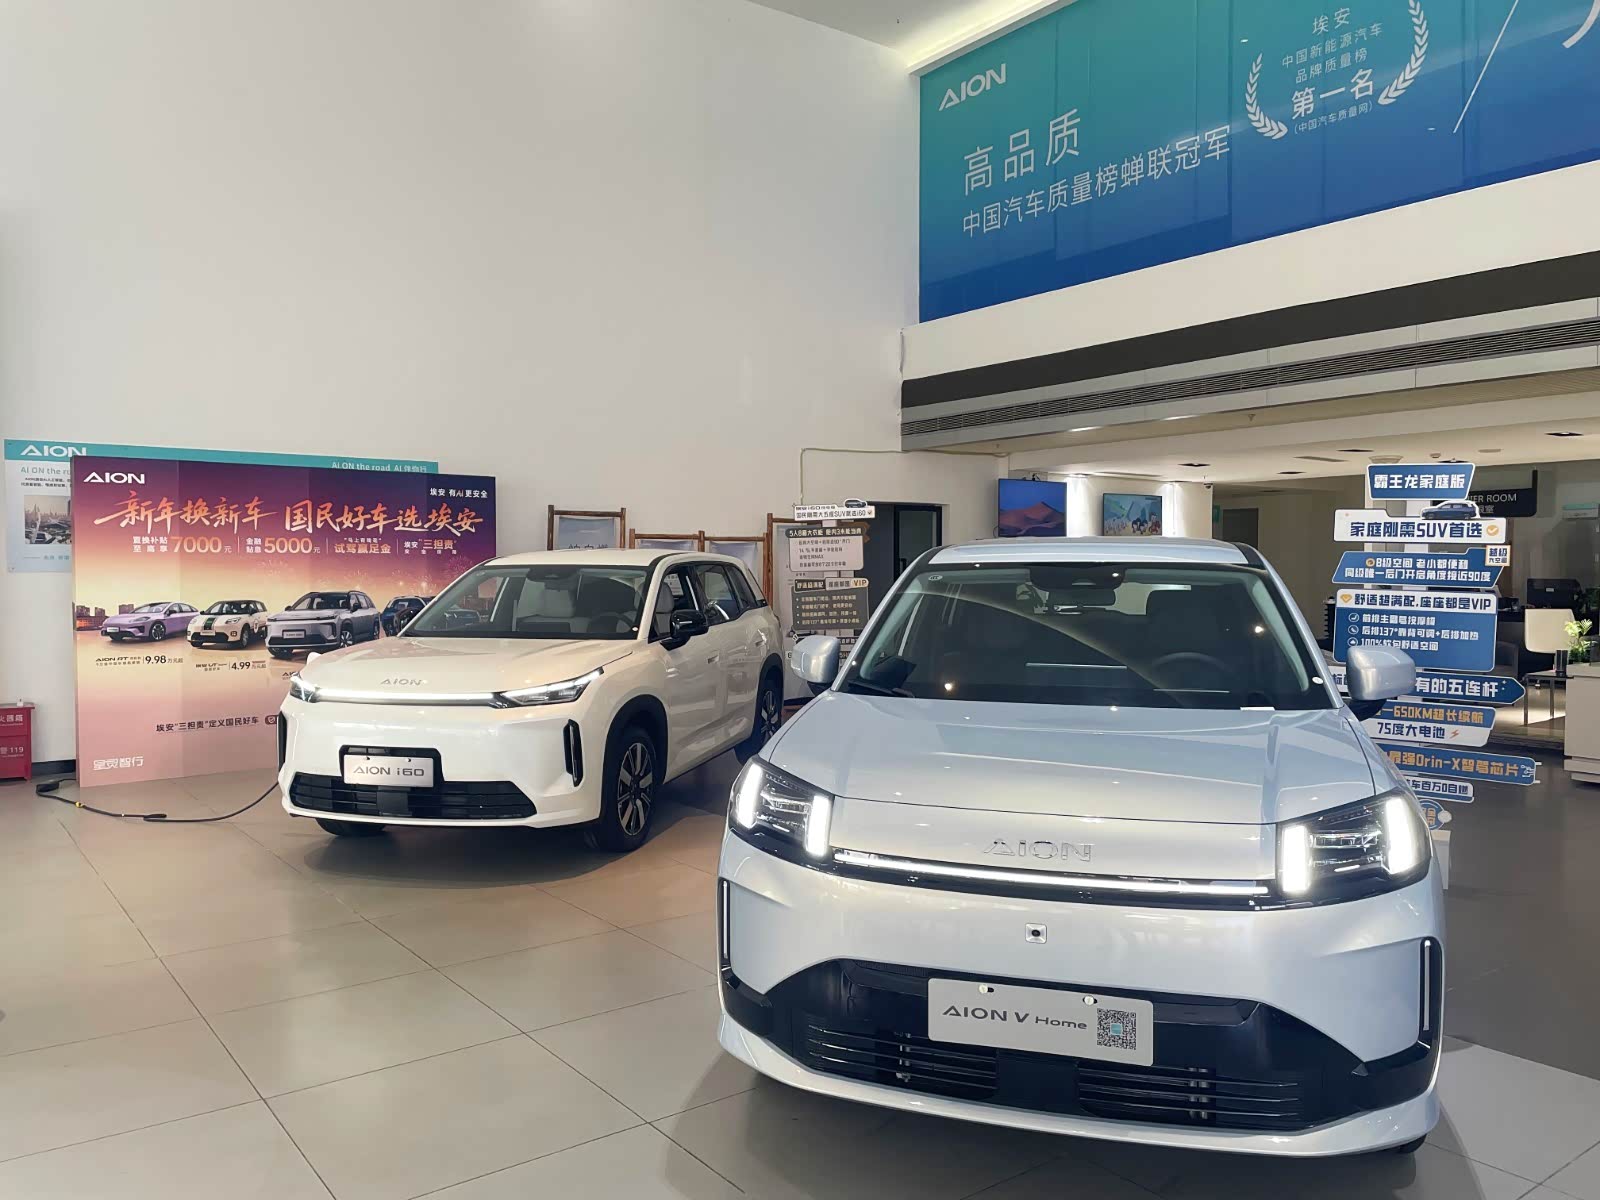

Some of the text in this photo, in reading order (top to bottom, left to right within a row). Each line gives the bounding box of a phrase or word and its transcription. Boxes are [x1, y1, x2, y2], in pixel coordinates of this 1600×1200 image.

[1312, 7, 1350, 35] 埃安
[1282, 23, 1383, 68] 中国新能源汽车
[1295, 48, 1367, 84] 品牌质量榜
[939, 63, 1006, 111] AION
[1291, 69, 1373, 120] 第一名
[964, 108, 1080, 196] 高品质
[963, 125, 1230, 238] 中国汽车质量榜蝉联冠军
[20, 445, 87, 457] AION
[357, 463, 370, 471] the
[372, 463, 391, 471] road
[83, 472, 145, 484] AION
[1374, 474, 1466, 489] 霸王龙家庭版
[430, 487, 445, 497] 埃安
[1487, 493, 1517, 502] ROOM
[94, 490, 483, 536] 新年换新车 国民好车选埃安
[1350, 521, 1482, 538] 家庭刚需SUV首选
[133, 536, 168, 545] 置换补贴
[246, 537, 262, 545] 金融
[246, 545, 262, 553] 贴息
[334, 543, 391, 554] 试驾赢足金
[1416, 558, 1469, 570] 老小都便利
[1344, 568, 1491, 582] 同级唯一后门开启角度接近90度
[380, 678, 422, 686] AION
[1415, 677, 1499, 698] 有的五连杆
[1376, 706, 1484, 724] 一650KM超长续航
[1377, 722, 1446, 739] 75度大电池
[353, 766, 425, 777] AION i60
[1384, 750, 1519, 777] 最强Orin-X智驾芯片
[1406, 778, 1469, 795] 车百万0自燃
[983, 838, 1092, 863] AION
[942, 1005, 1088, 1030] AION V Home
